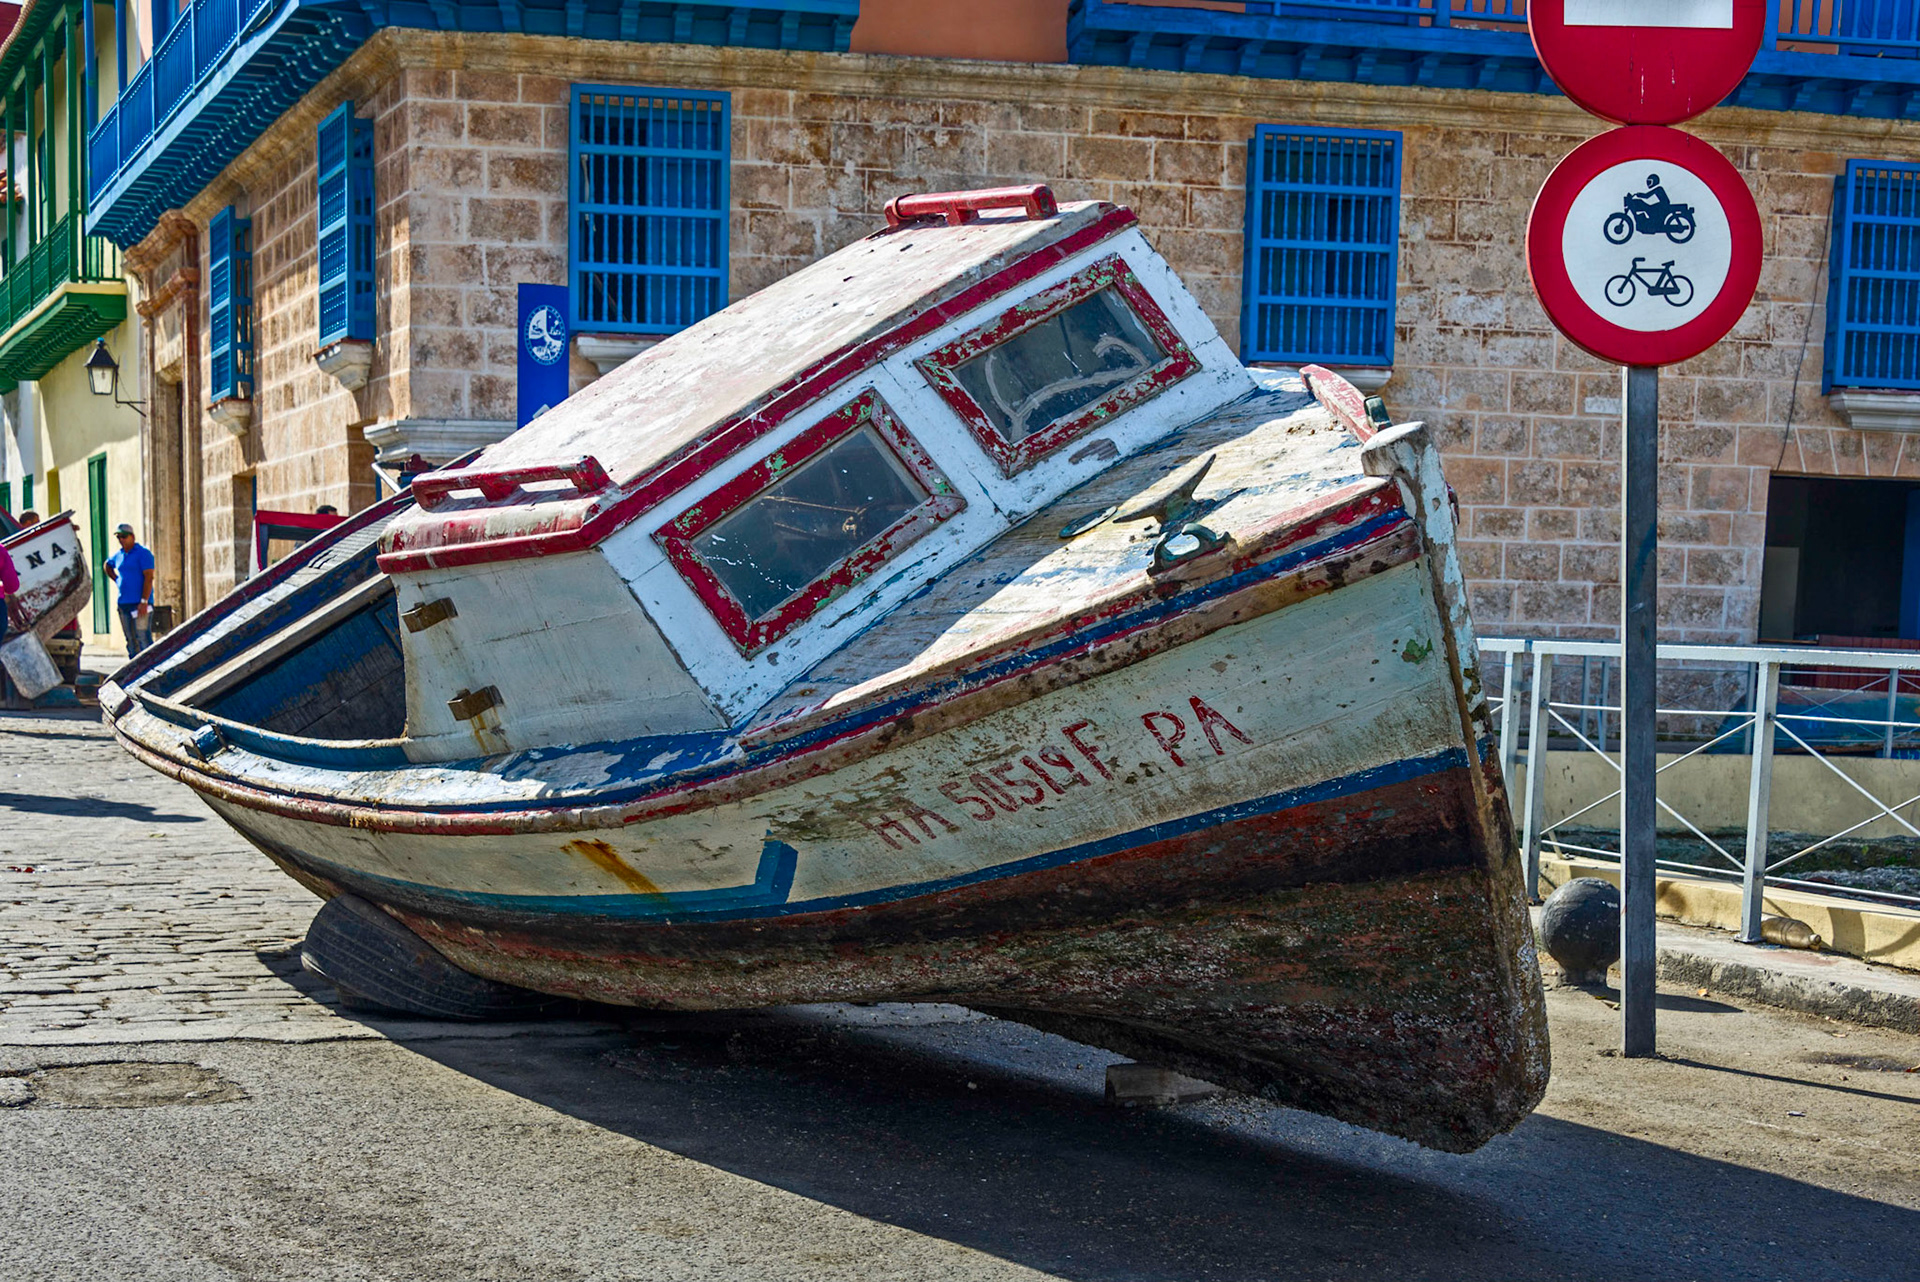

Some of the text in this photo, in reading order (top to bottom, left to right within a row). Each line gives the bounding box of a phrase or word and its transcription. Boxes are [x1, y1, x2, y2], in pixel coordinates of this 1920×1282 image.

[16, 543, 67, 575] NA
[858, 797, 958, 850] HA
[1140, 696, 1254, 767] PA
